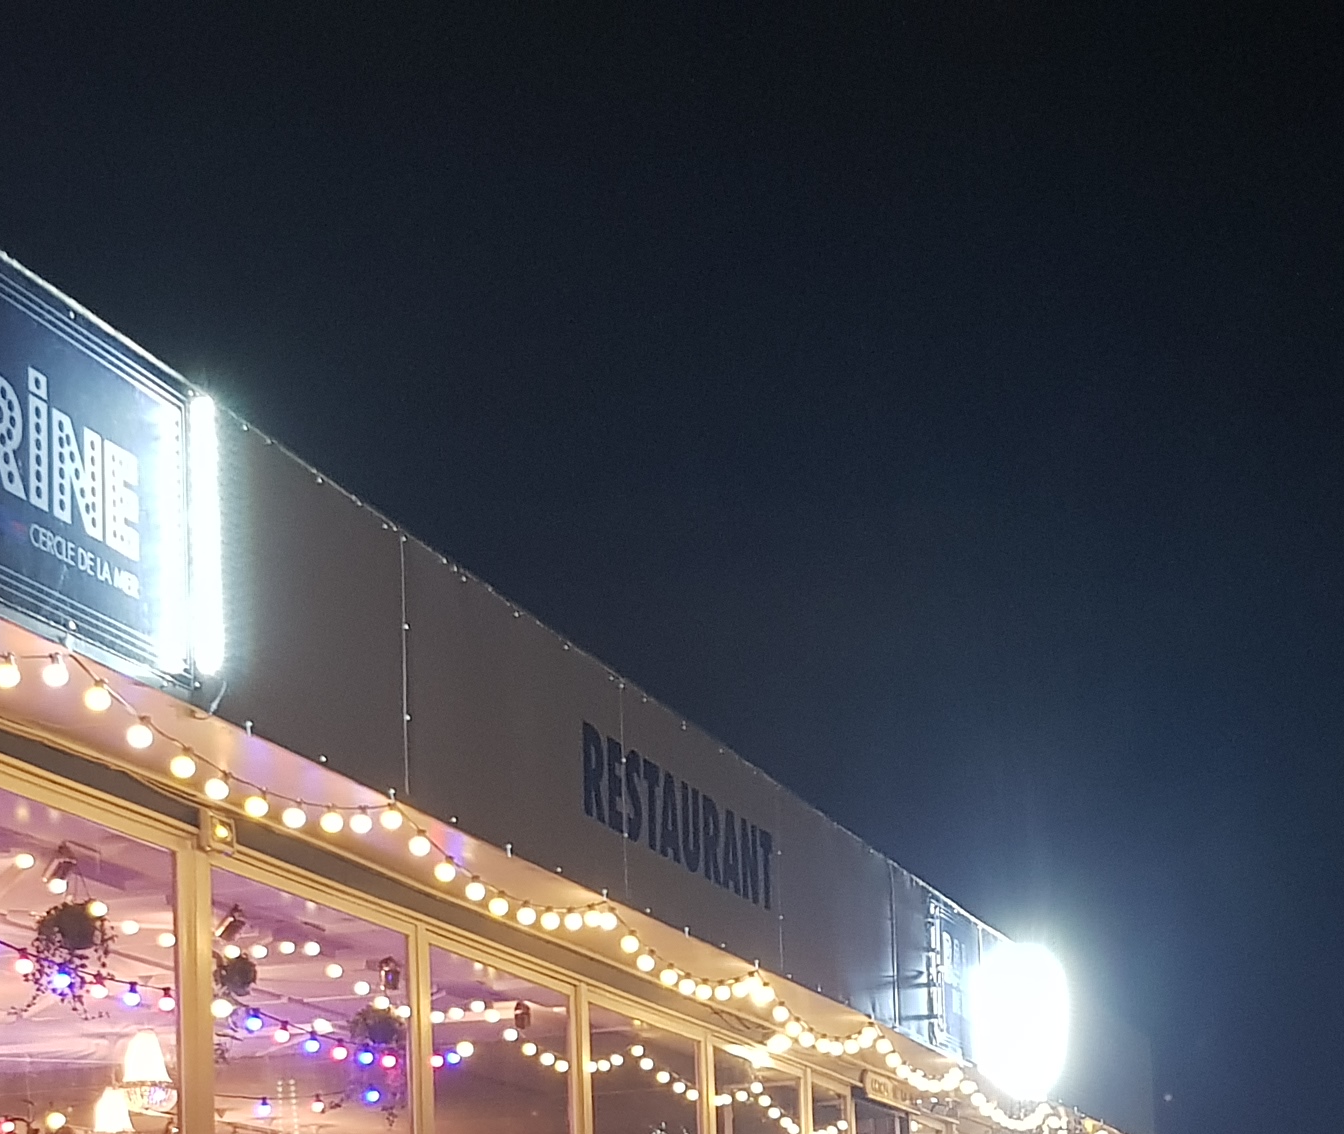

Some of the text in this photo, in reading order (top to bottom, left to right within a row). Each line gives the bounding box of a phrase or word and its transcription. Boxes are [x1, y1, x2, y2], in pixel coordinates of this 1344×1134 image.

[29, 523, 76, 567] CERCLE
[77, 546, 95, 577] DE
[96, 557, 113, 587] LA
[582, 720, 773, 911] RESTAURANT
